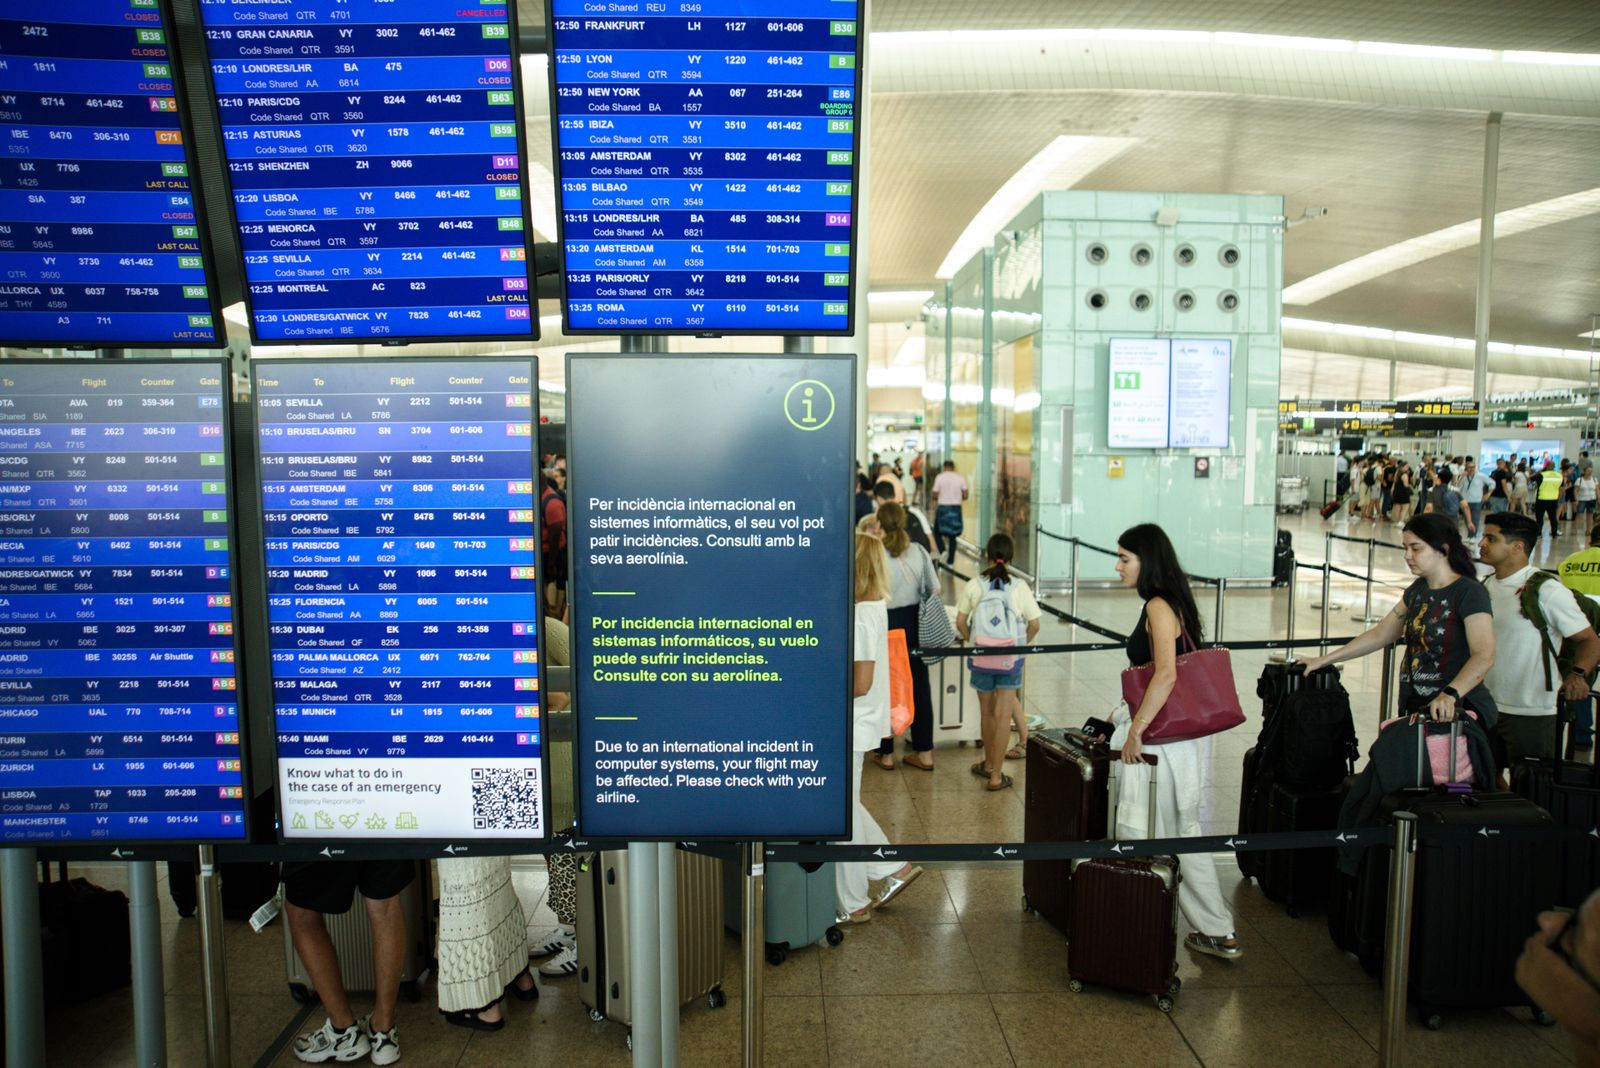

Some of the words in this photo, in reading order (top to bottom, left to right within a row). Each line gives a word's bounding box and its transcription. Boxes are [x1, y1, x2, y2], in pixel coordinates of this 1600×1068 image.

[555, 21, 579, 29] 12:50
[585, 21, 645, 30] FRANKFURT
[688, 22, 700, 30] LH
[725, 22, 746, 31] 1127
[768, 23, 803, 31] 601-606
[835, 24, 852, 32] B30
[23, 26, 48, 36] 2472
[141, 32, 160, 40] B38
[207, 31, 231, 39] 12:10
[237, 30, 266, 38] GRAN
[268, 30, 313, 38] CANARIA
[339, 29, 352, 37] VY
[376, 29, 398, 37] 3002
[420, 28, 455, 36] 461-462
[486, 27, 504, 35] B39
[301, 46, 320, 54] QTR
[335, 45, 354, 53] 3591
[558, 88, 582, 96] 12:50
[588, 88, 611, 96] NEW
[612, 88, 640, 96] YORK
[689, 88, 703, 96] AA
[730, 89, 746, 97] 067
[767, 89, 802, 97] 251-264
[833, 90, 850, 98] E86
[12, 130, 29, 138] IBE
[50, 131, 72, 139] 8470
[159, 133, 177, 141] C71
[20, 163, 35, 171] UX
[57, 164, 79, 172] 7706
[766, 304, 799, 312] 501-514
[282, 313, 369, 321] LONDRES/GATWICK
[509, 309, 527, 317] D04
[82, 379, 106, 388] Flight
[390, 377, 415, 386] Flight
[1118, 374, 1136, 387] T1
[288, 456, 357, 464] BRUSELAS/BRU
[590, 498, 613, 510] Per
[618, 498, 685, 510] incidència
[689, 498, 775, 510] internacional
[779, 501, 795, 510] en
[590, 516, 649, 528] sistemes
[654, 516, 730, 530] informàtics,
[735, 516, 746, 528] el
[751, 519, 775, 528] seu
[779, 517, 799, 528] vol
[803, 517, 824, 531] pot
[591, 535, 620, 549] patir
[624, 534, 702, 546] incidències.
[707, 534, 761, 546] Consulti
[765, 535, 794, 546] amb
[799, 535, 810, 546] la
[591, 555, 622, 564] seva
[626, 552, 688, 564] aerolínia.
[593, 617, 617, 628] Por
[622, 617, 694, 629] incidencia
[699, 617, 791, 629] internacional
[796, 620, 812, 628] en
[593, 635, 656, 646] sistemas
[661, 635, 754, 648] informáticos,
[759, 638, 775, 646] su
[780, 635, 818, 646] vuelo
[593, 653, 637, 666] puede
[641, 653, 679, 664] sufrir
[683, 653, 768, 664] incidencias.
[594, 670, 657, 681] Consulte
[661, 673, 687, 681] con
[692, 673, 708, 681] su
[713, 670, 782, 681] aerolínea.
[596, 741, 622, 752] Due
[626, 742, 638, 752] to
[642, 743, 658, 752] an
[663, 741, 743, 752] international
[748, 741, 799, 752] incident
[802, 741, 813, 751] in
[596, 759, 657, 772] computer
[661, 759, 718, 772] systems,
[723, 760, 752, 772] your
[755, 757, 787, 772] flight
[791, 760, 818, 771] may
[287, 768, 320, 778] Know
[325, 769, 354, 778] what
[358, 769, 370, 778] to
[374, 769, 388, 778] do
[392, 768, 402, 778] in
[596, 775, 612, 786] be
[617, 775, 672, 786] affected.
[677, 775, 721, 786] Please
[725, 775, 764, 786] check
[767, 775, 793, 786] with
[797, 777, 826, 788] your
[288, 782, 308, 791] the
[312, 784, 337, 792] case
[341, 782, 353, 791] of
[375, 784, 441, 794] emergency
[597, 791, 639, 803] airline.
